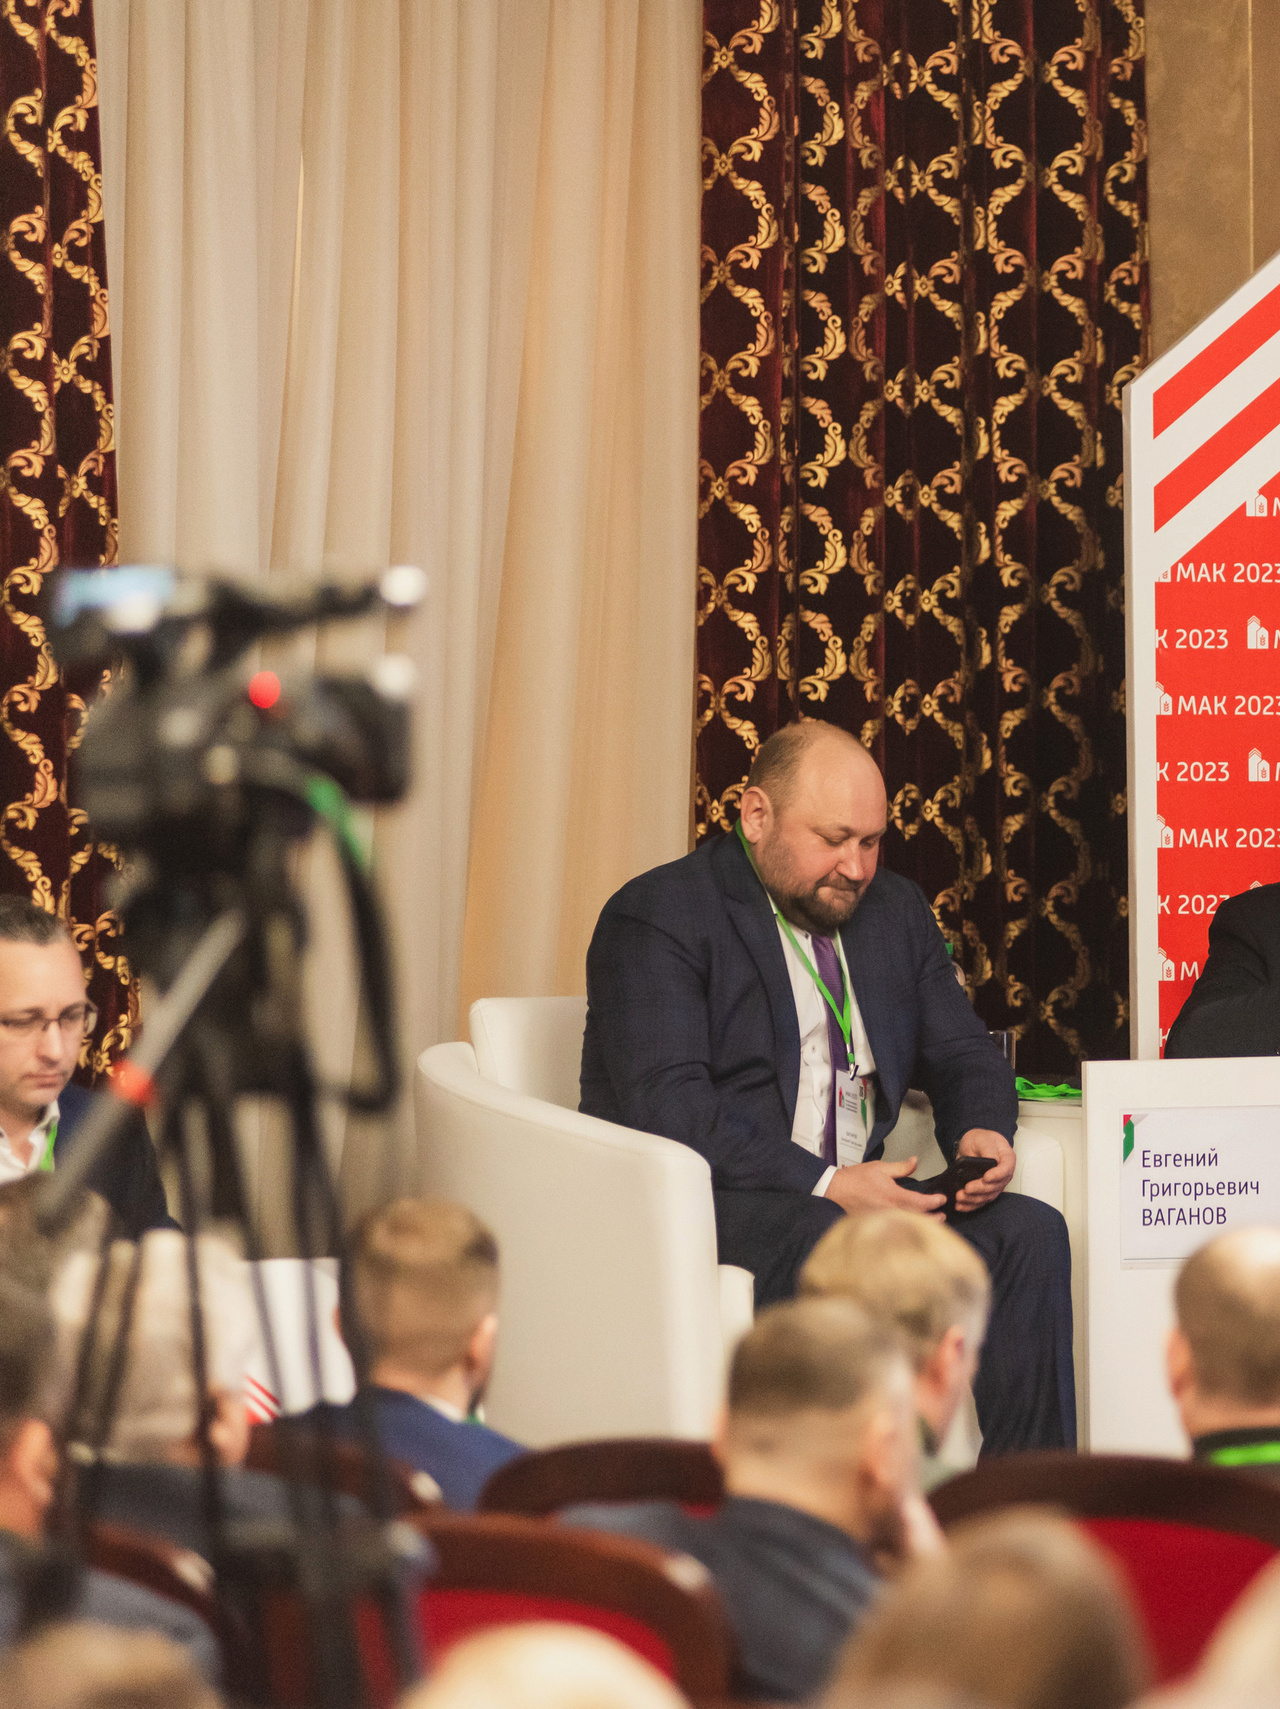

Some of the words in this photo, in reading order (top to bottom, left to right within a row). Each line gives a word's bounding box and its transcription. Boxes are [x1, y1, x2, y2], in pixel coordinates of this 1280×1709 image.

[1176, 562, 1227, 583] МАК
[1175, 628, 1229, 650] 2023
[1177, 695, 1228, 716] МАК
[1176, 761, 1230, 782] 2023
[1178, 828, 1229, 848] МАК
[1177, 894, 1231, 915] 202
[1141, 1147, 1219, 1168] Евгений
[1141, 1179, 1260, 1203] Григорьевич
[1141, 1206, 1227, 1227] ВАГАНОВ
